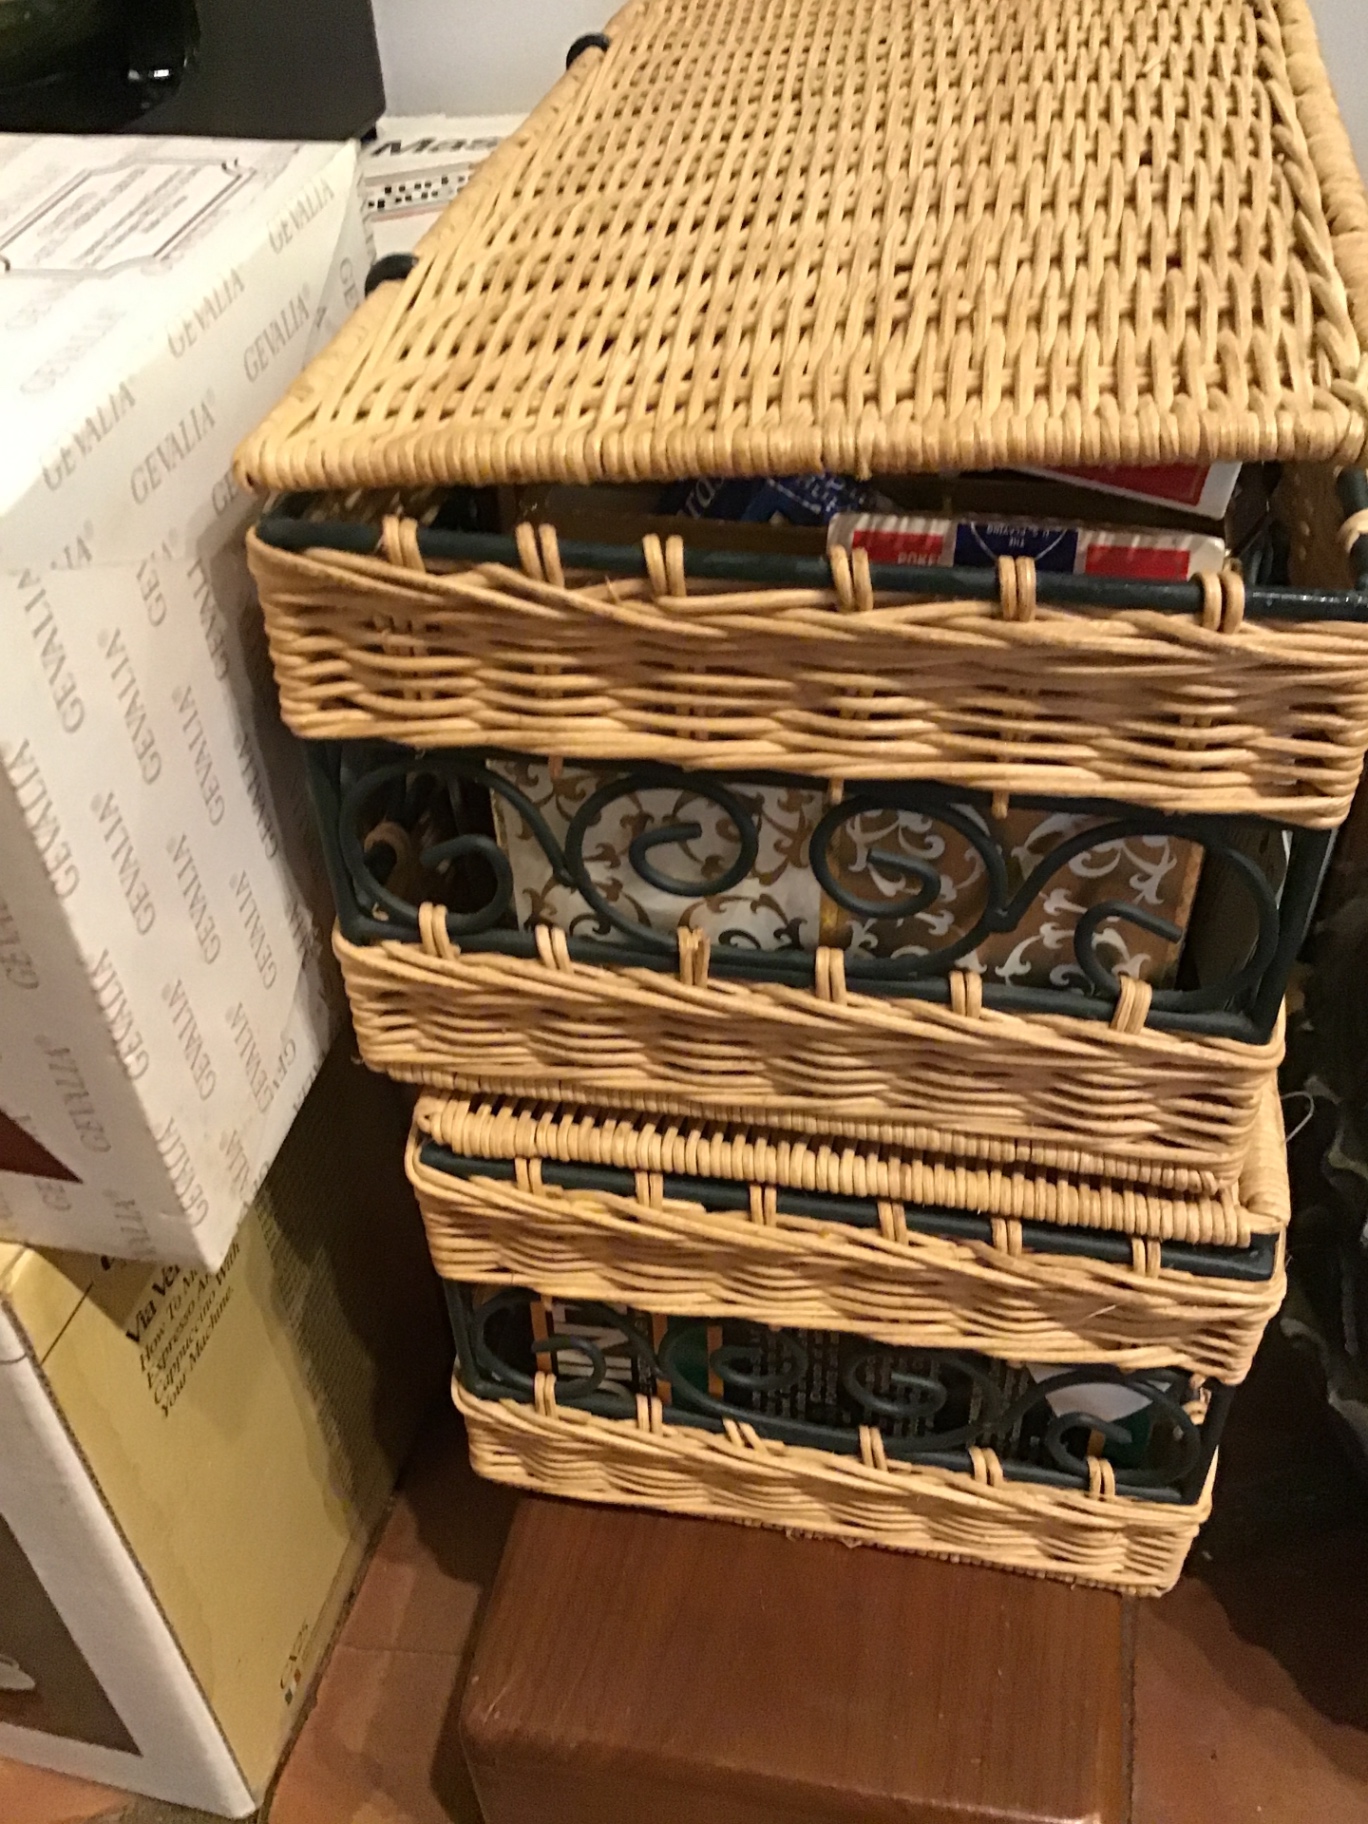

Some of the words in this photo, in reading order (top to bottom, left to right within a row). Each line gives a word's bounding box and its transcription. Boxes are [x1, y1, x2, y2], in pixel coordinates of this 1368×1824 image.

[243, 291, 312, 383] GEVALIA
[129, 401, 217, 505] GEVALIA
[17, 569, 86, 734] GEVALIA
[105, 627, 163, 786] GEVALIA
[176, 685, 226, 828] GEVALIA
[99, 791, 156, 936] GEVALIA
[171, 834, 223, 966] GEVALIA
[239, 869, 279, 991] GEVALIA
[88, 949, 151, 1082] GEVALIA
[168, 978, 217, 1102] GEVALIA
[125, 1299, 158, 1344] Via
[139, 1321, 166, 1373] How
[166, 1294, 182, 1322] To
[153, 1289, 216, 1406] Cappuccino
[214, 1241, 241, 1287] With
[161, 1373, 187, 1419] Your
